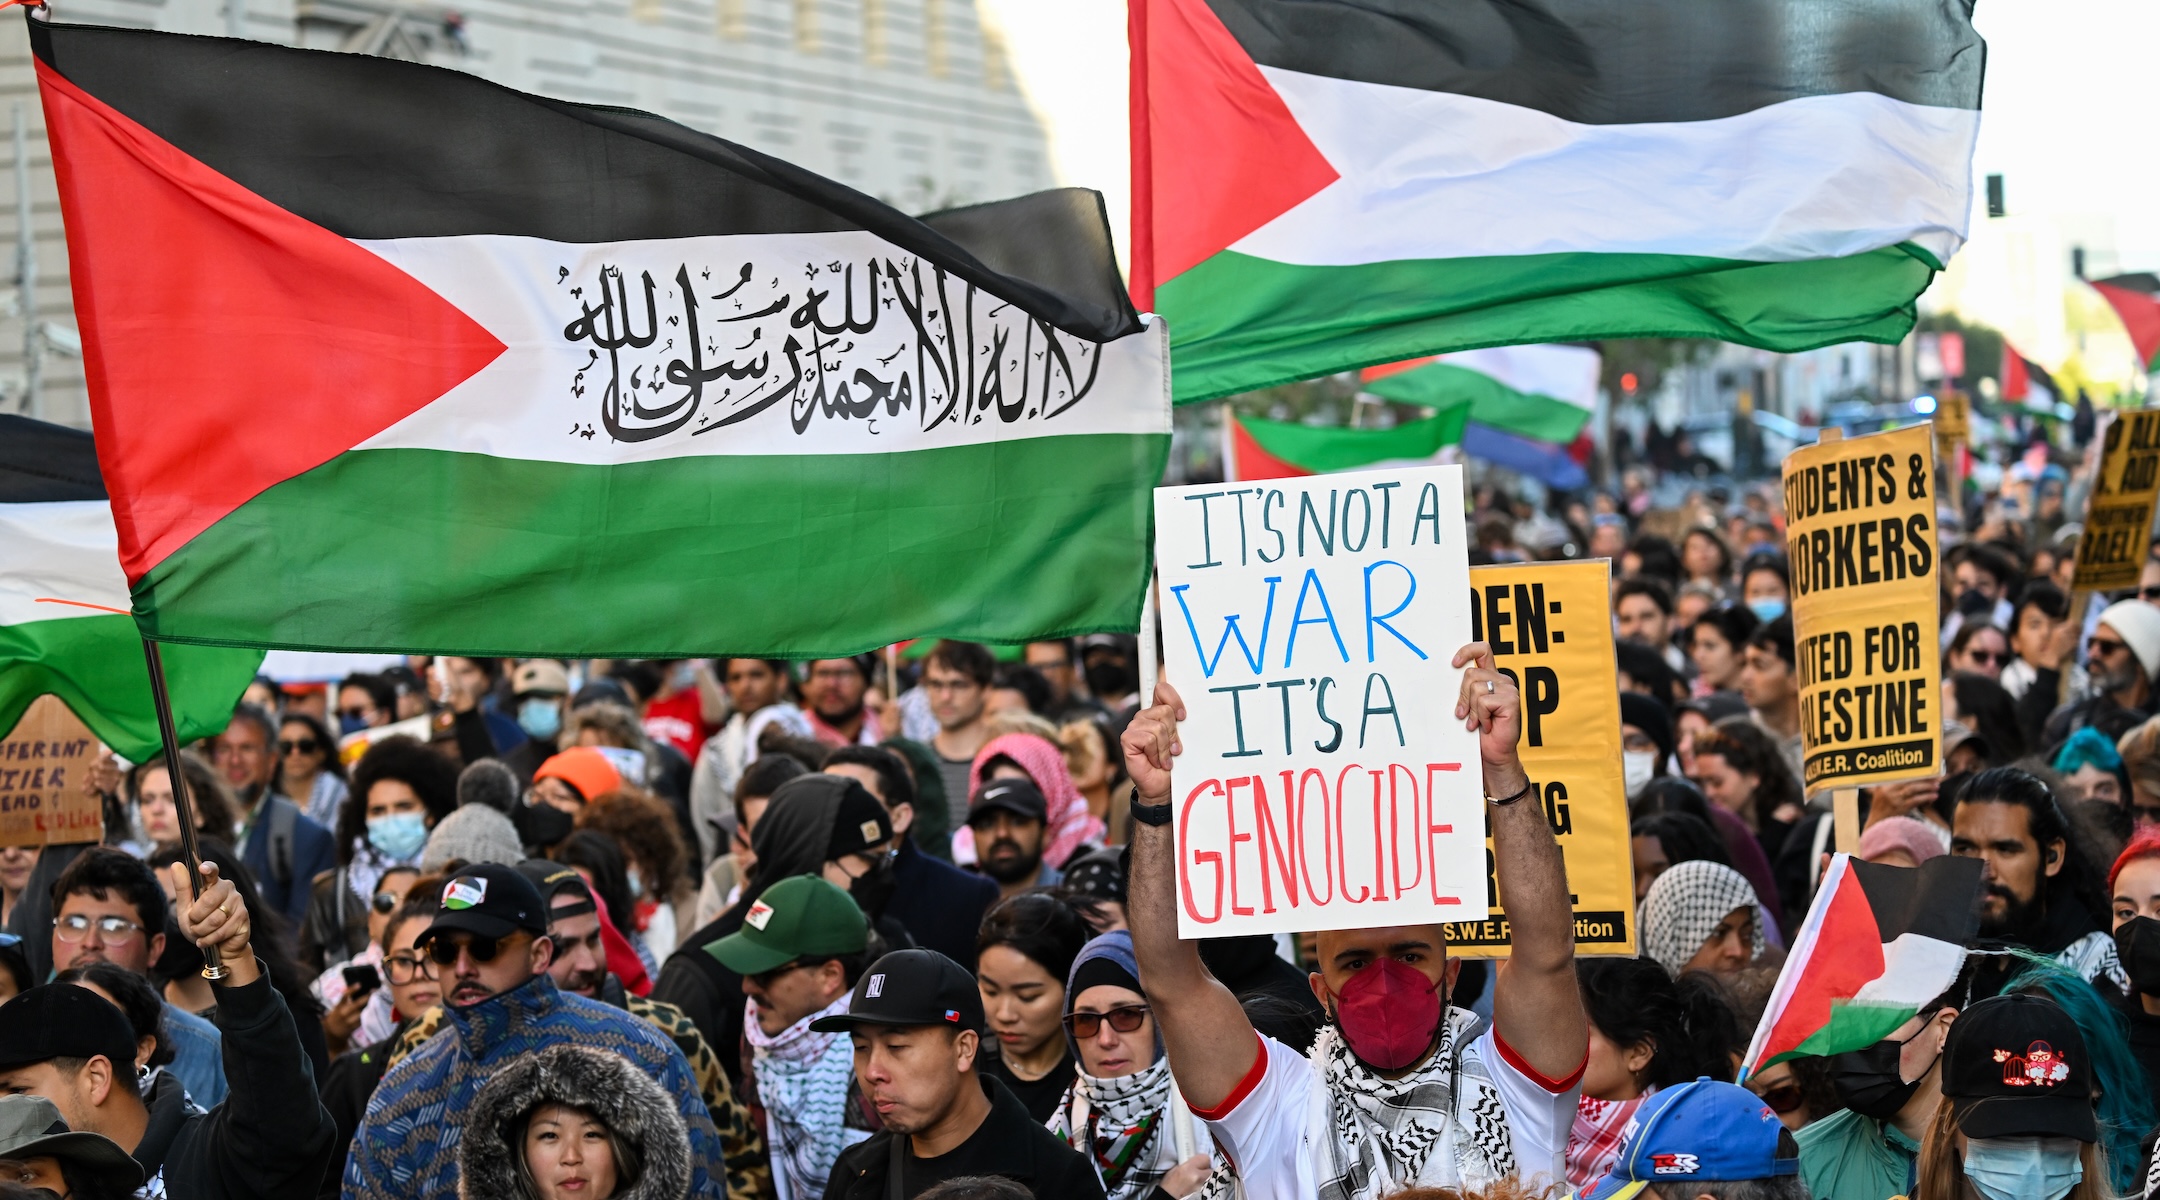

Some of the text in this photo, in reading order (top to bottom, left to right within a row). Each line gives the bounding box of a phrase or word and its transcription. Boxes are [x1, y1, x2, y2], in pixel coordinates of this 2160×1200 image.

[1184, 481, 1440, 570] IT'S NOT A
[1785, 453, 1927, 528] STUDENTS &
[1170, 560, 1429, 678] WAR
[1865, 621, 1920, 677] FOR
[1208, 672, 1406, 758] IT'S A
[1856, 749, 1923, 770] Coalition
[1178, 763, 1462, 924] GENOCIDE
